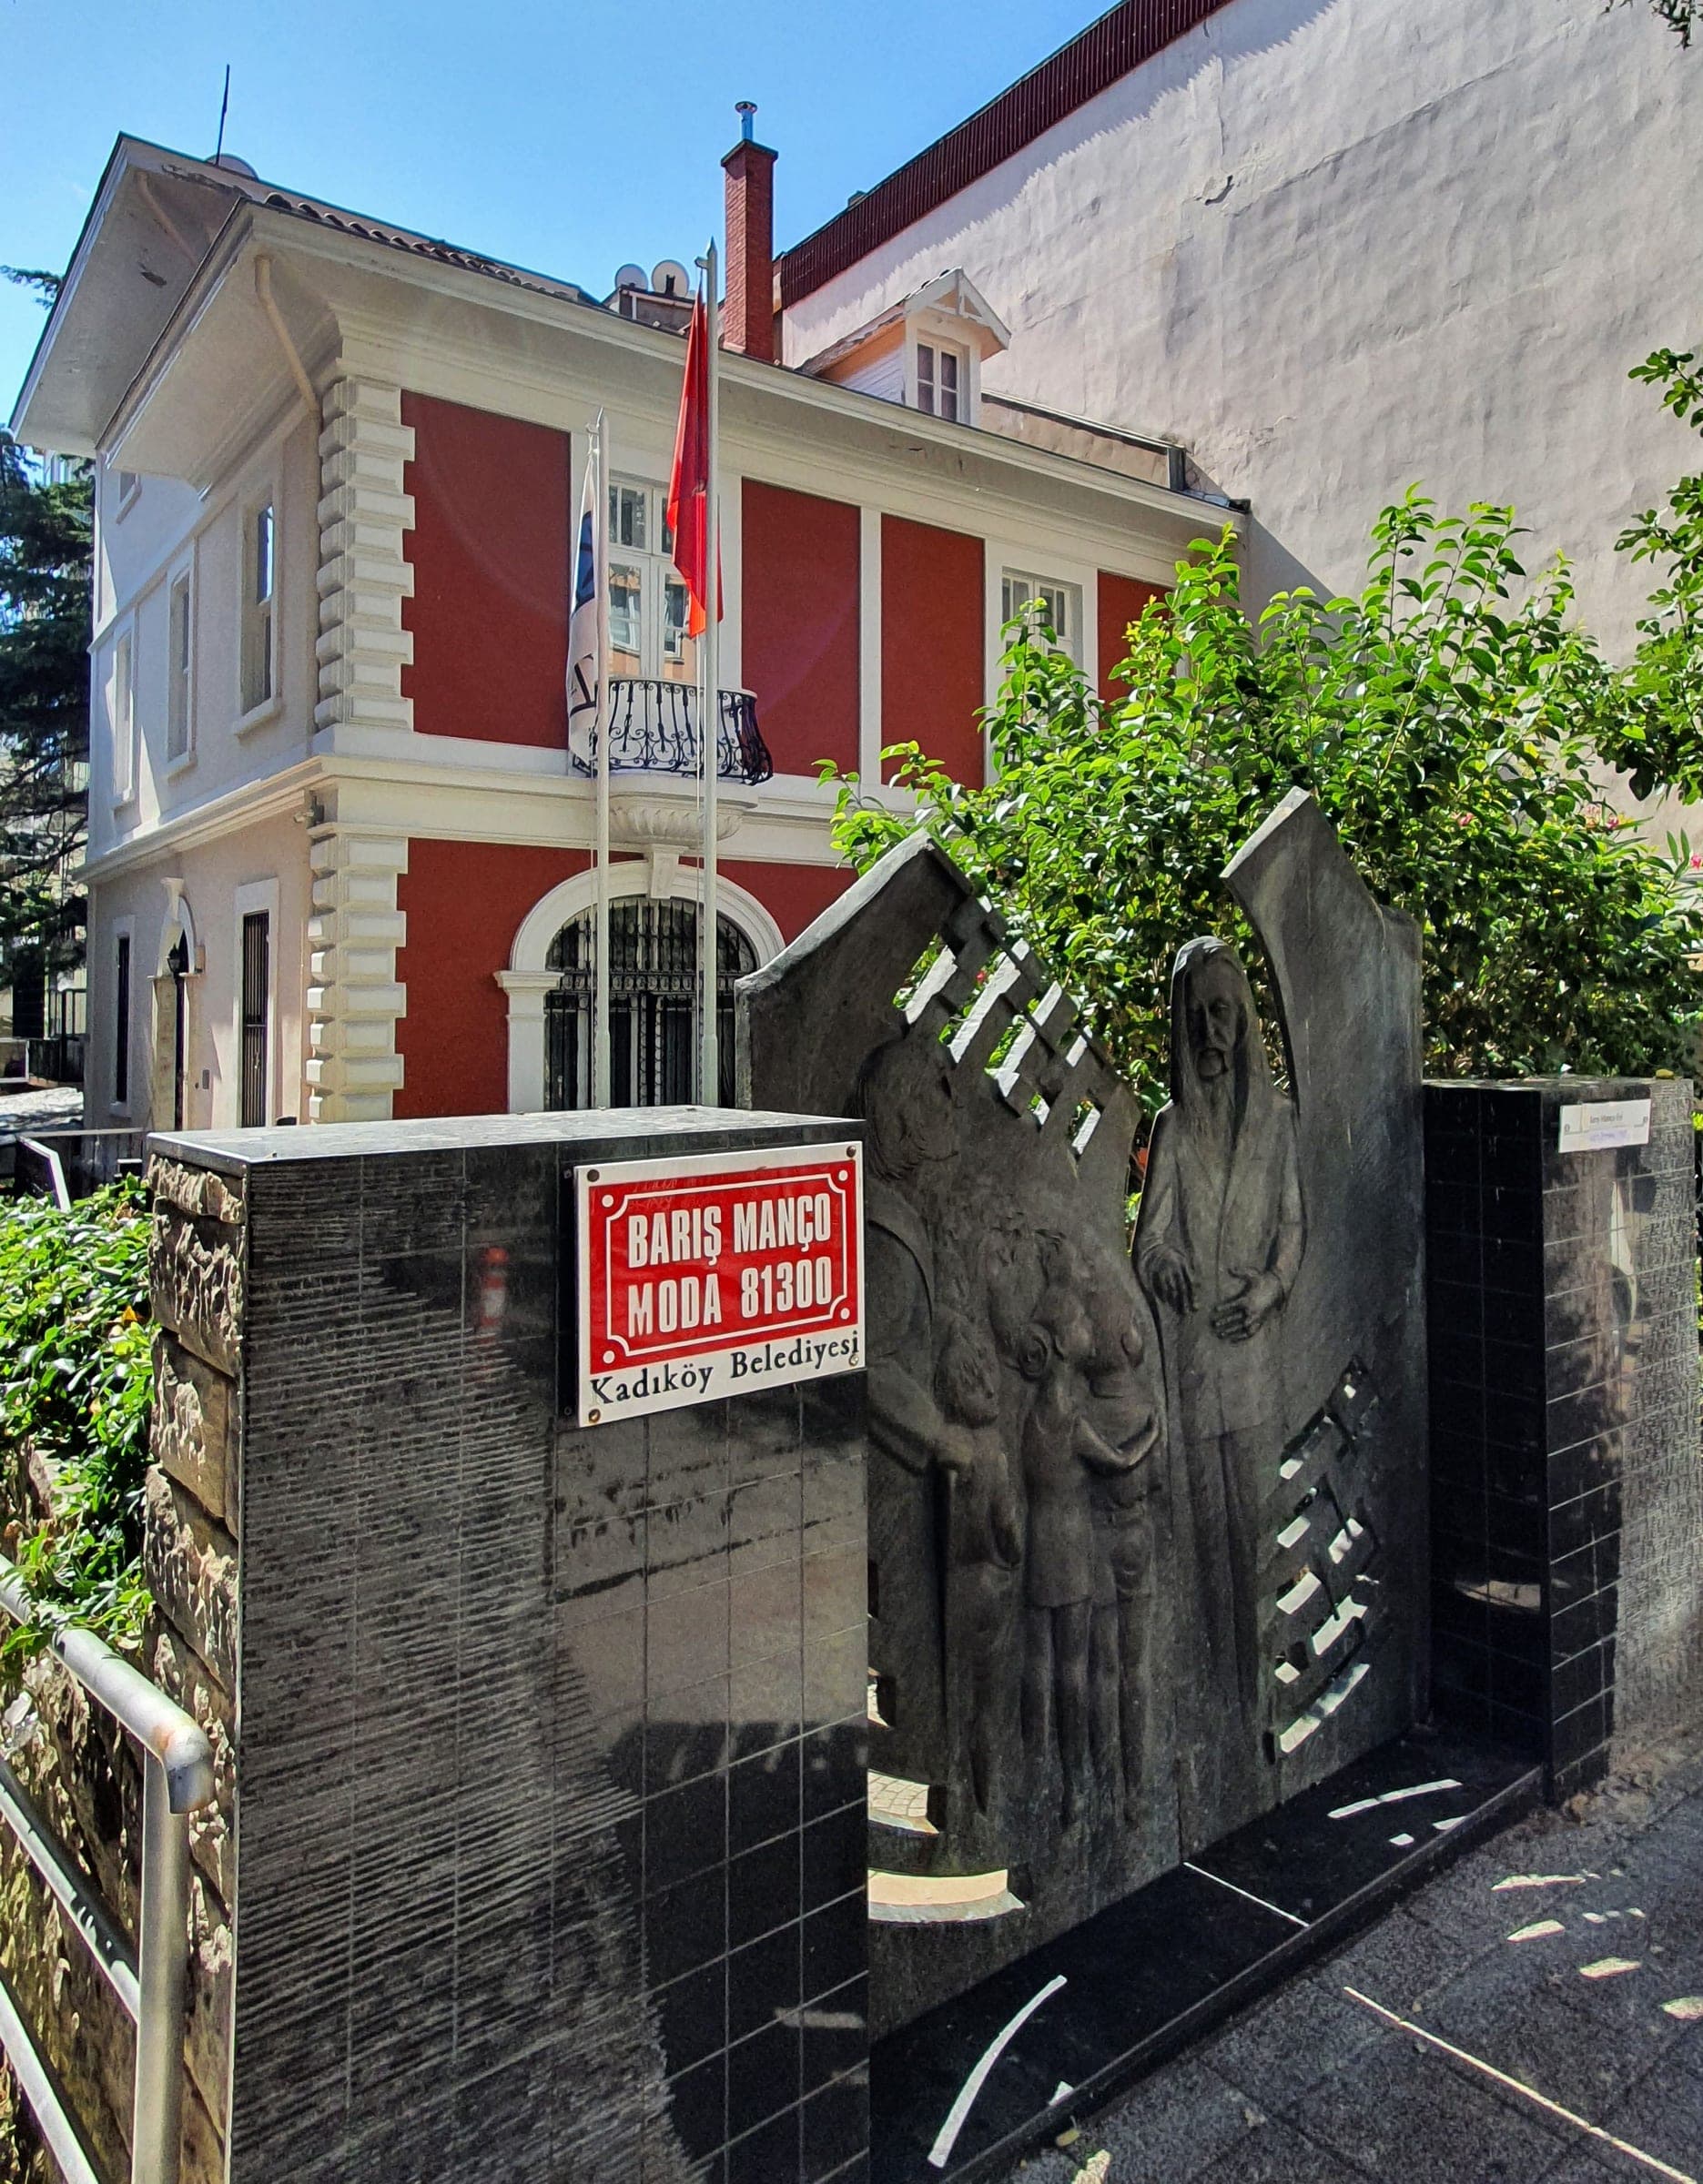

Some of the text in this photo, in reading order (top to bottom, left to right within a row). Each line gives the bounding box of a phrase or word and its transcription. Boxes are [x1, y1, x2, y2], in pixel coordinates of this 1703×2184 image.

[628, 1193, 831, 1266] BARIŞ MANÇO
[628, 1256, 832, 1338] MODA 81300
[591, 1330, 859, 1404] Kadıköy Belediyesi
